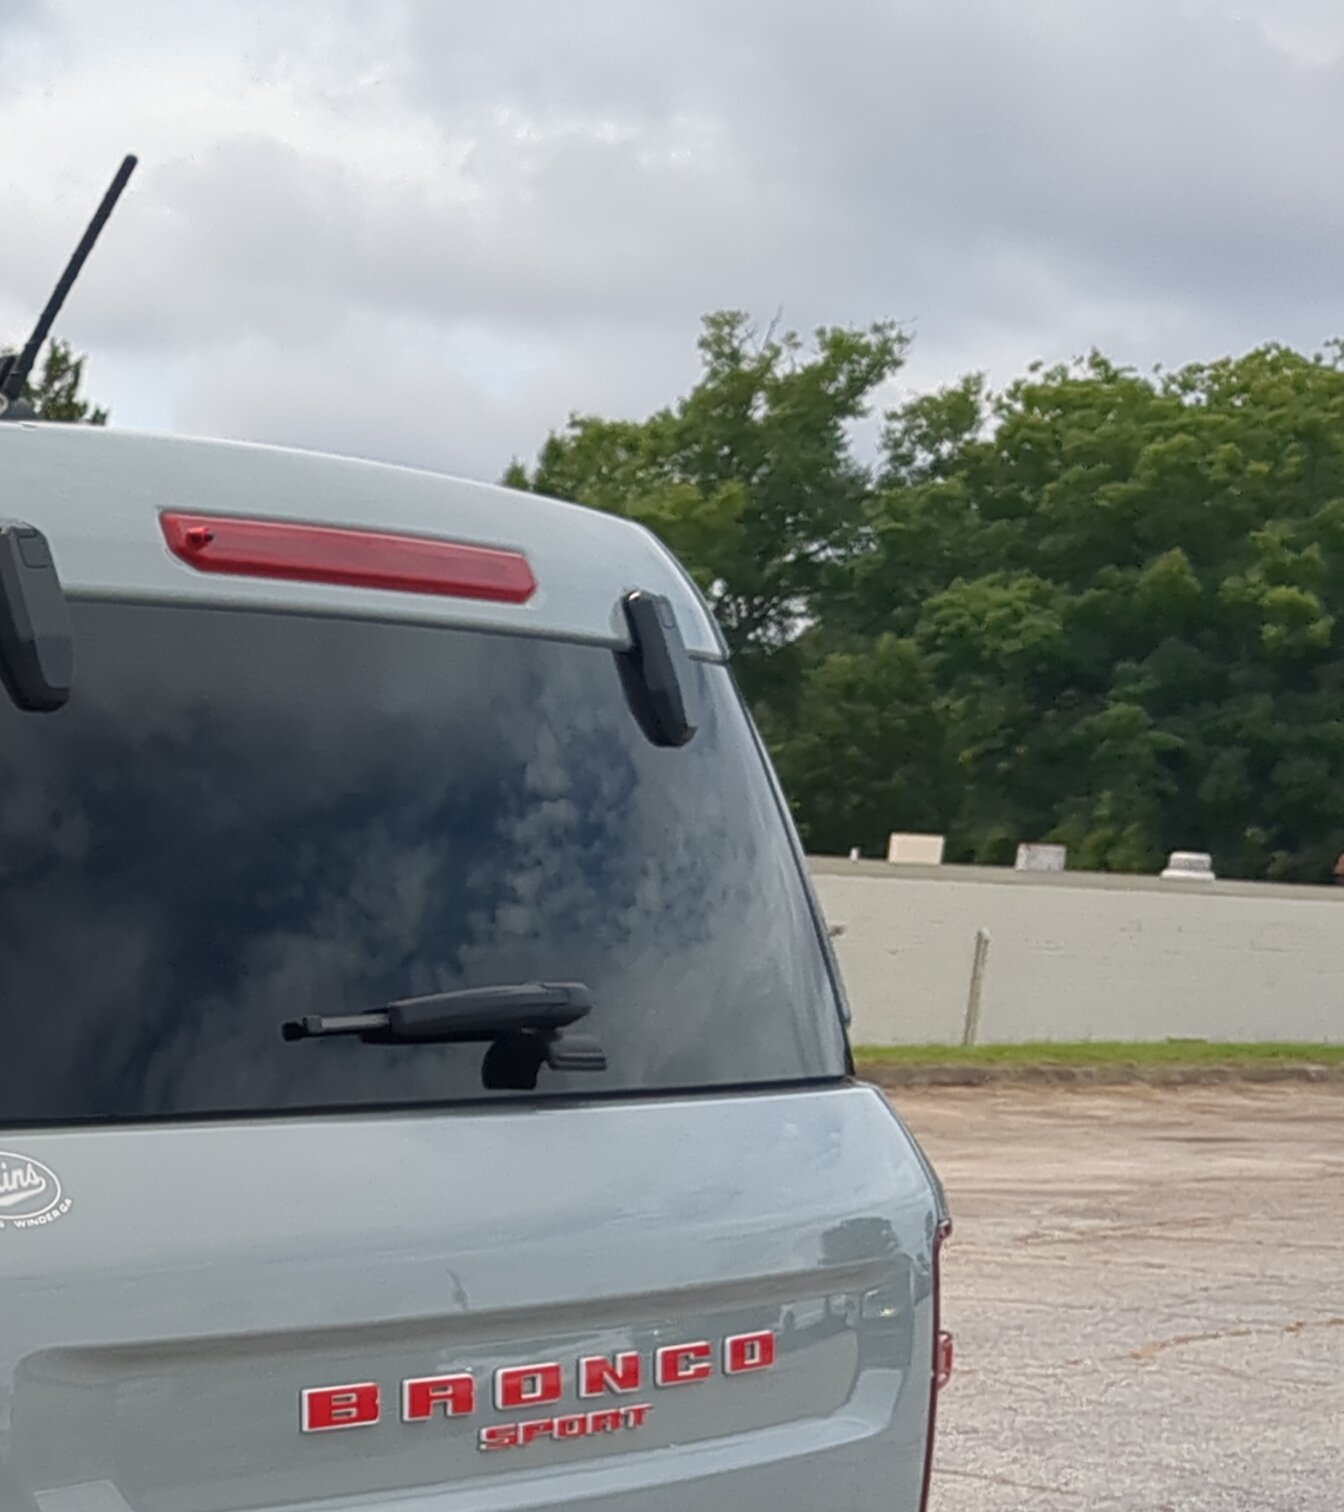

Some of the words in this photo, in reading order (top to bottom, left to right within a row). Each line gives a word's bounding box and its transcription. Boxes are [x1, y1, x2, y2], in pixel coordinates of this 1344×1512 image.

[14, 1211, 61, 1228] WINDER
[59, 1199, 72, 1213] GA
[301, 1329, 777, 1432] BRONCO
[479, 1403, 653, 1451] SPORT
